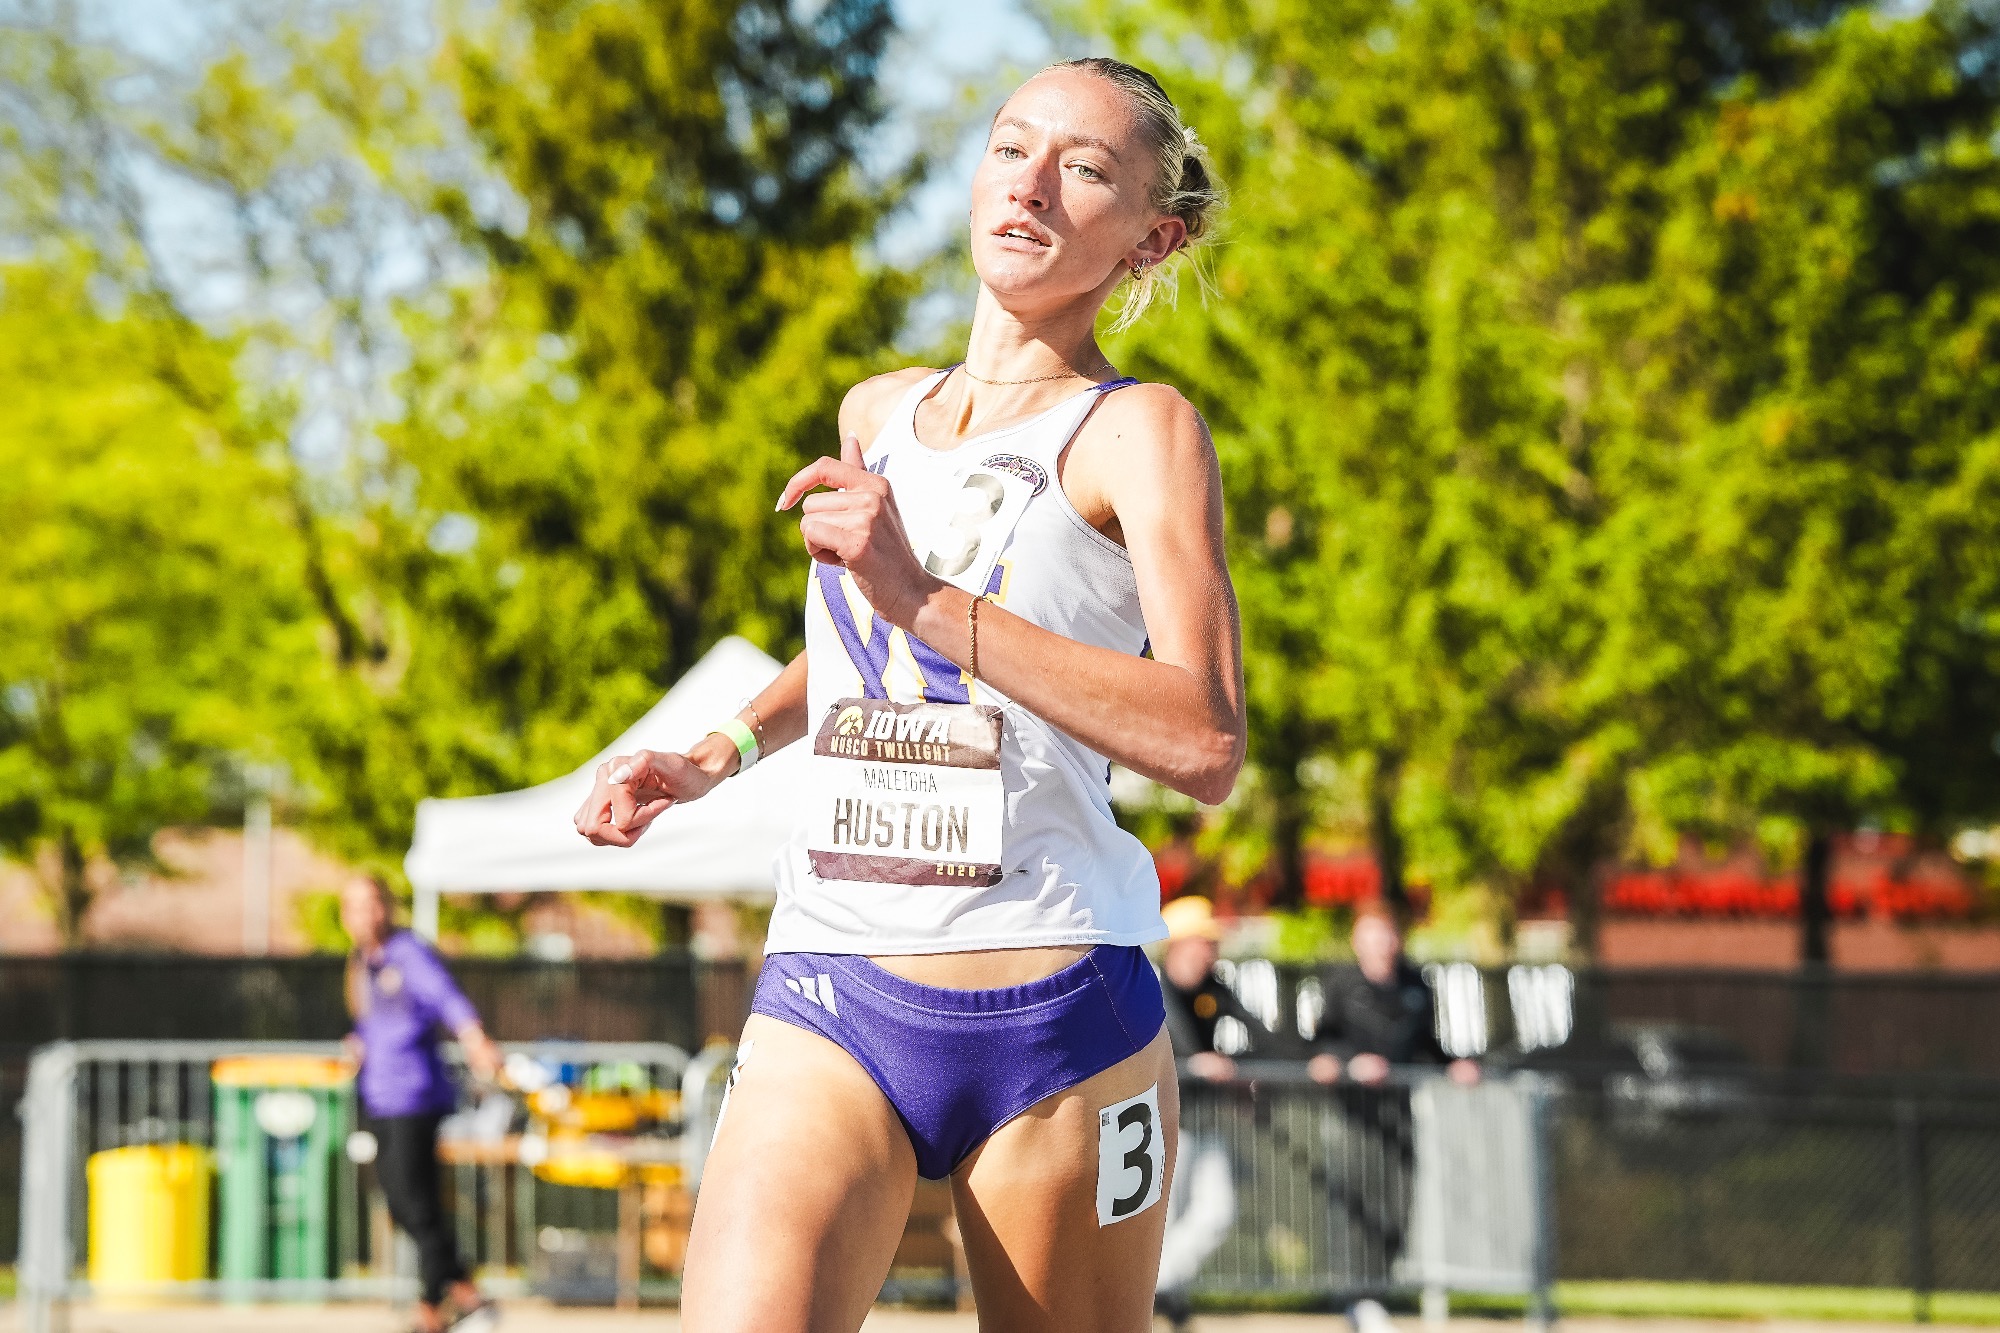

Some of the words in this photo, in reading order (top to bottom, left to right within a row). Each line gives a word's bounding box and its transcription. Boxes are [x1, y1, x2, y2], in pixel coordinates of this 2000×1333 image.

[925, 473, 1004, 576] 3
[863, 709, 951, 744] IOWA
[830, 735, 869, 757] MUSCO
[875, 740, 951, 763] TWILIGHT
[863, 767, 938, 793] MALEIGHA
[833, 797, 969, 854] HUSTON
[936, 862, 976, 878] 2026
[1111, 1102, 1153, 1217] 3
